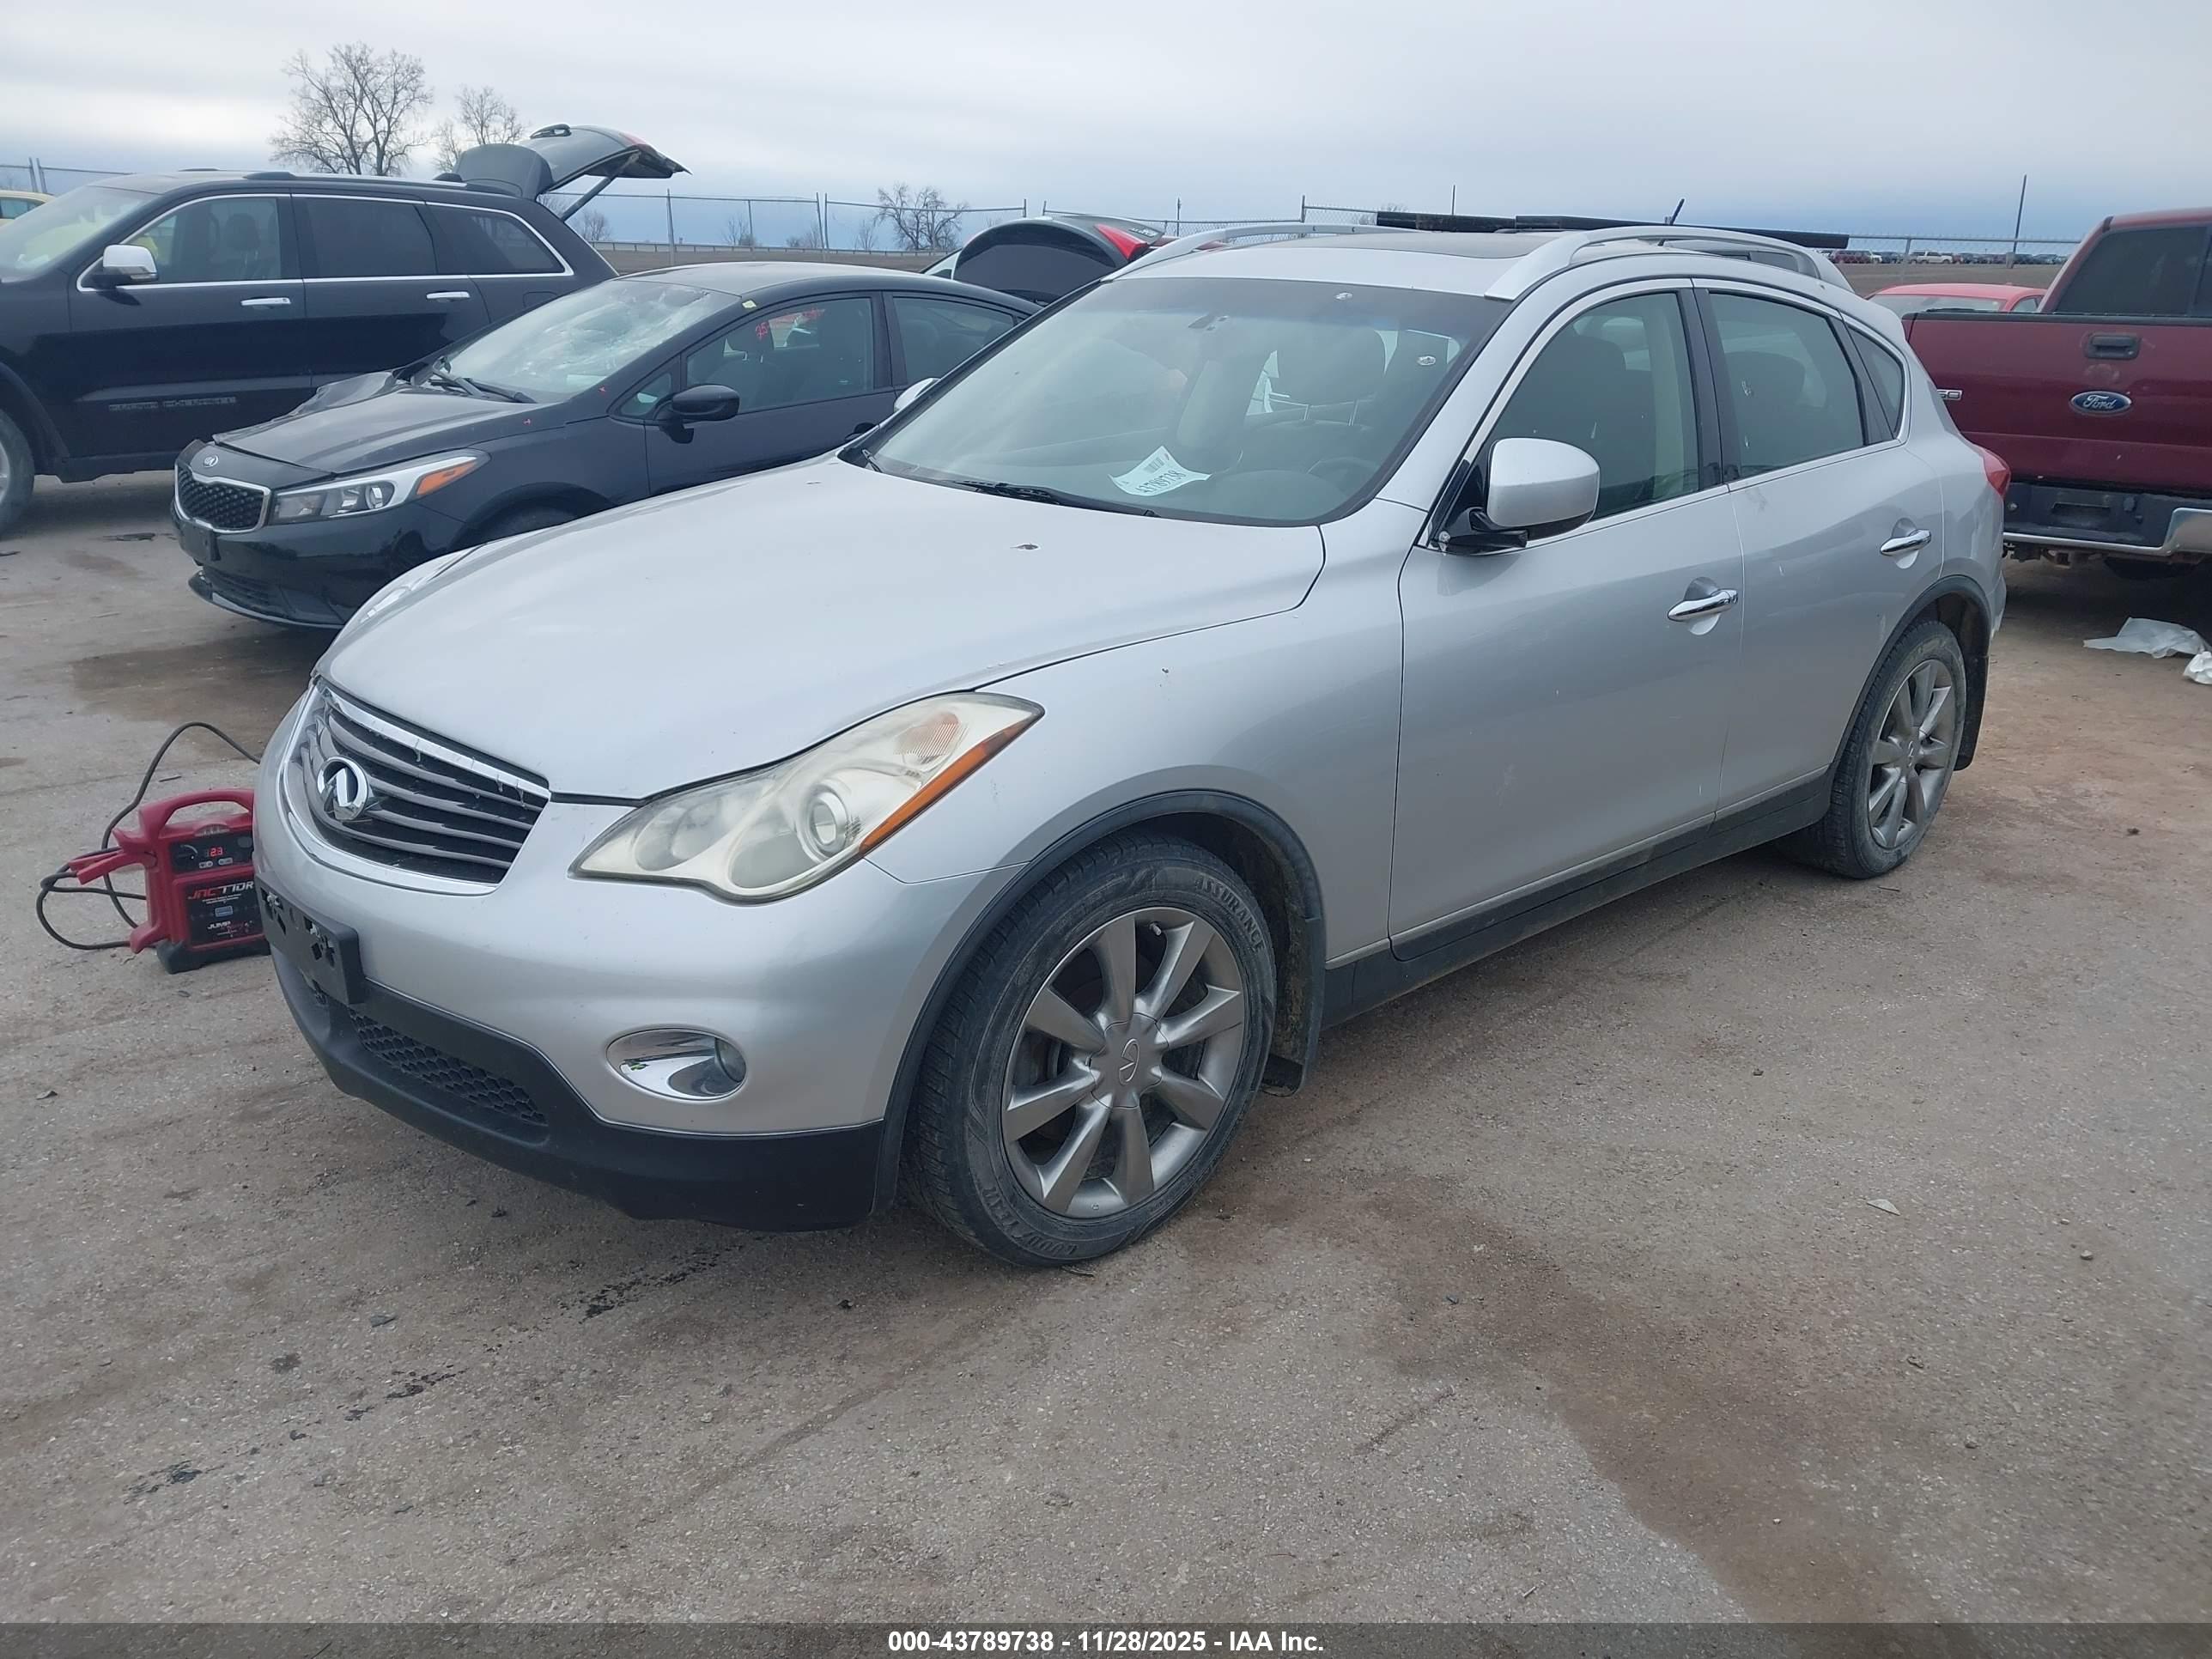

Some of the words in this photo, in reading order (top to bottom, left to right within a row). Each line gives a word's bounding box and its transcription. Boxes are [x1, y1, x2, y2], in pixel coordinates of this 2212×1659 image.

[2082, 394, 2118, 410] Ford
[1134, 470, 1188, 494] 43789738
[1195, 876, 1267, 951] ASSURANCE
